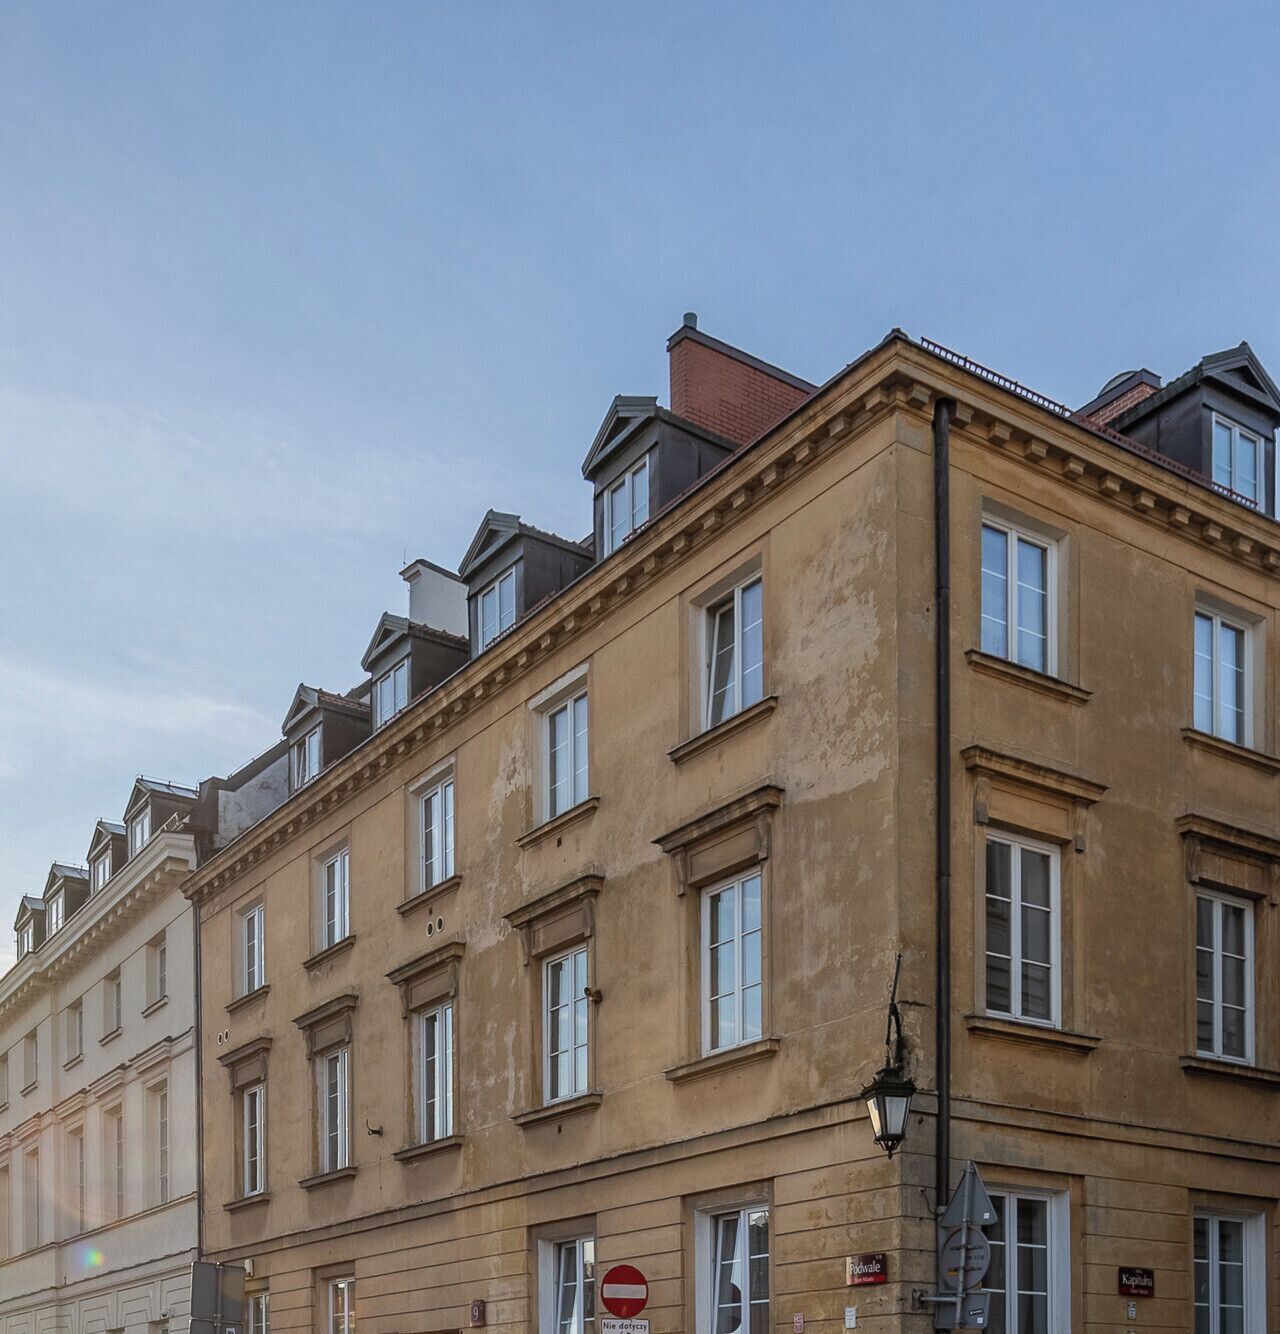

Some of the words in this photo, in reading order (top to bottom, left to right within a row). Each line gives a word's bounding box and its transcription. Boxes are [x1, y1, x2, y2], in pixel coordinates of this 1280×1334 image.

[849, 1260, 881, 1275] Podwale
[1122, 1273, 1153, 1288] Kapitulna
[472, 1306, 479, 1321] 9
[603, 1322, 616, 1330] Nie
[619, 1321, 647, 1332] dotyczy
